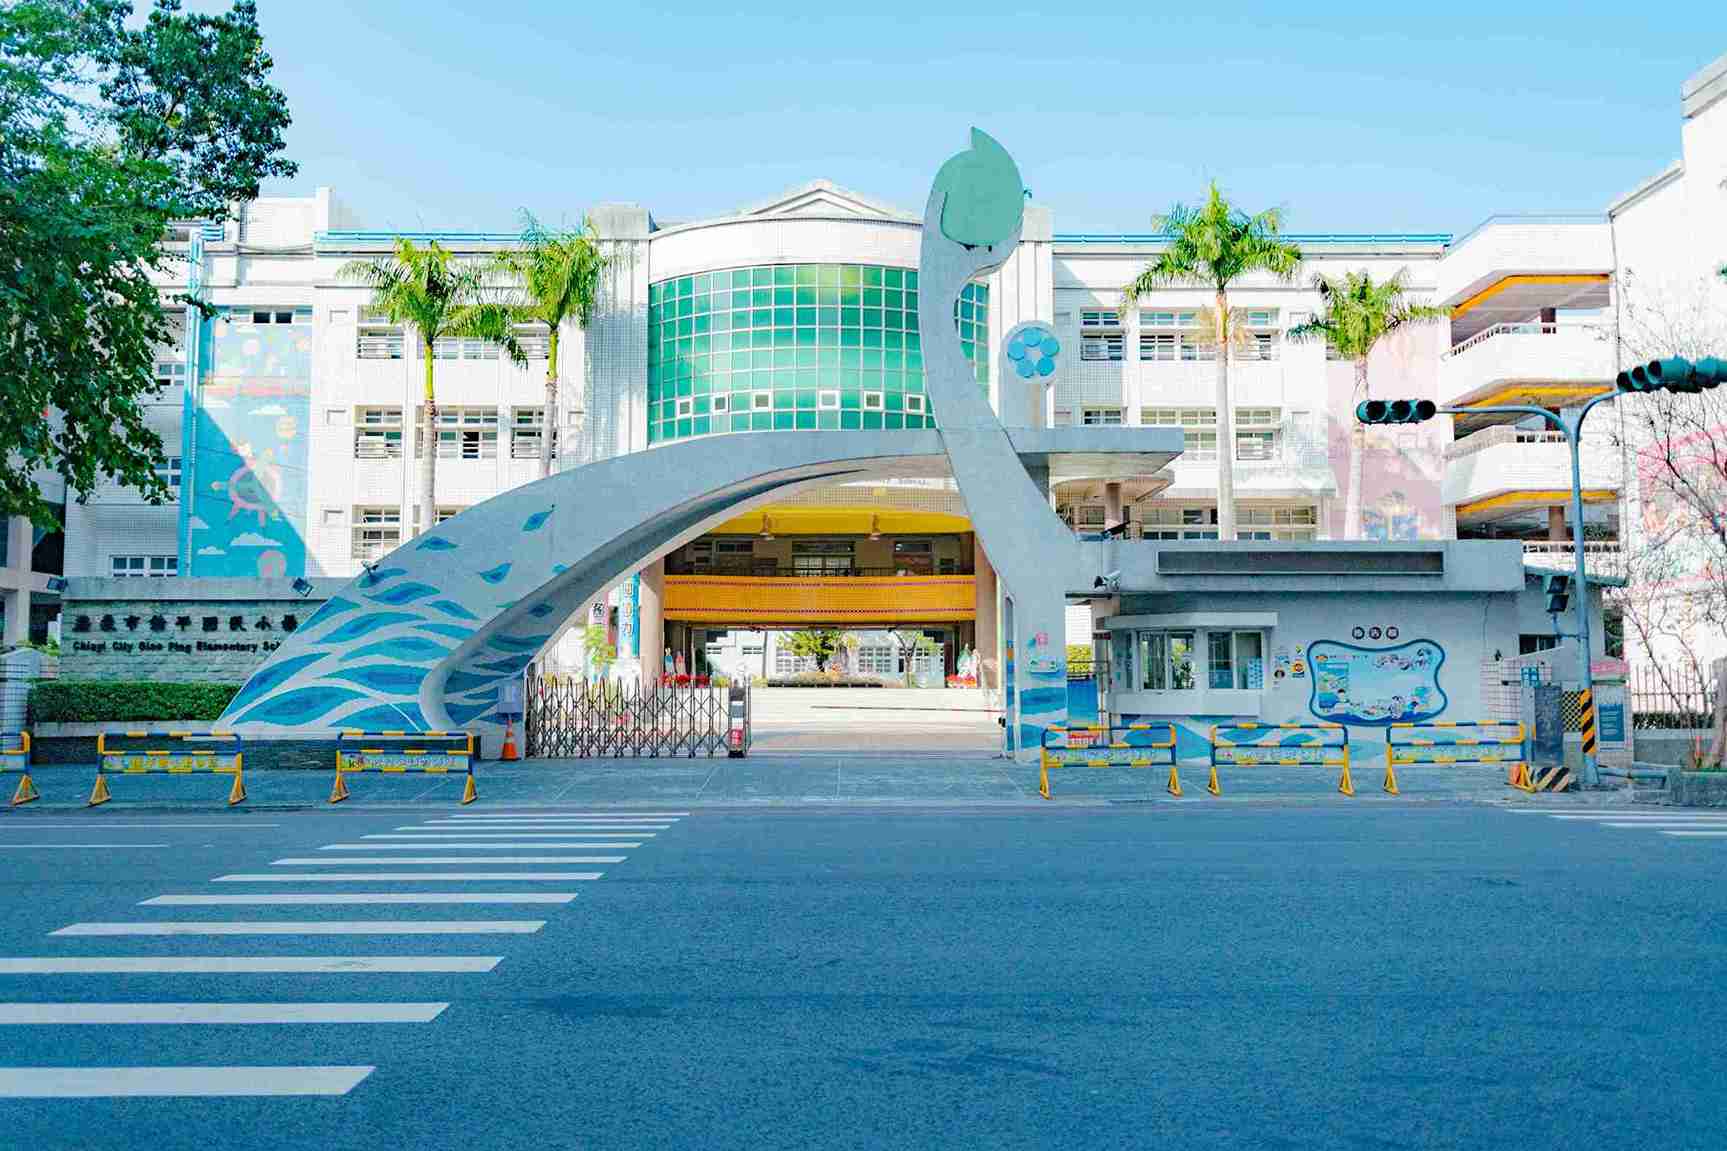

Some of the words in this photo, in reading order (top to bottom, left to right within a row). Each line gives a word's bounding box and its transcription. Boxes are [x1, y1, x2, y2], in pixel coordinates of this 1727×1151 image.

[112, 641, 133, 653] City
[168, 641, 192, 654] Ping
[196, 641, 257, 653] Elementary
[263, 641, 280, 651] Sch
